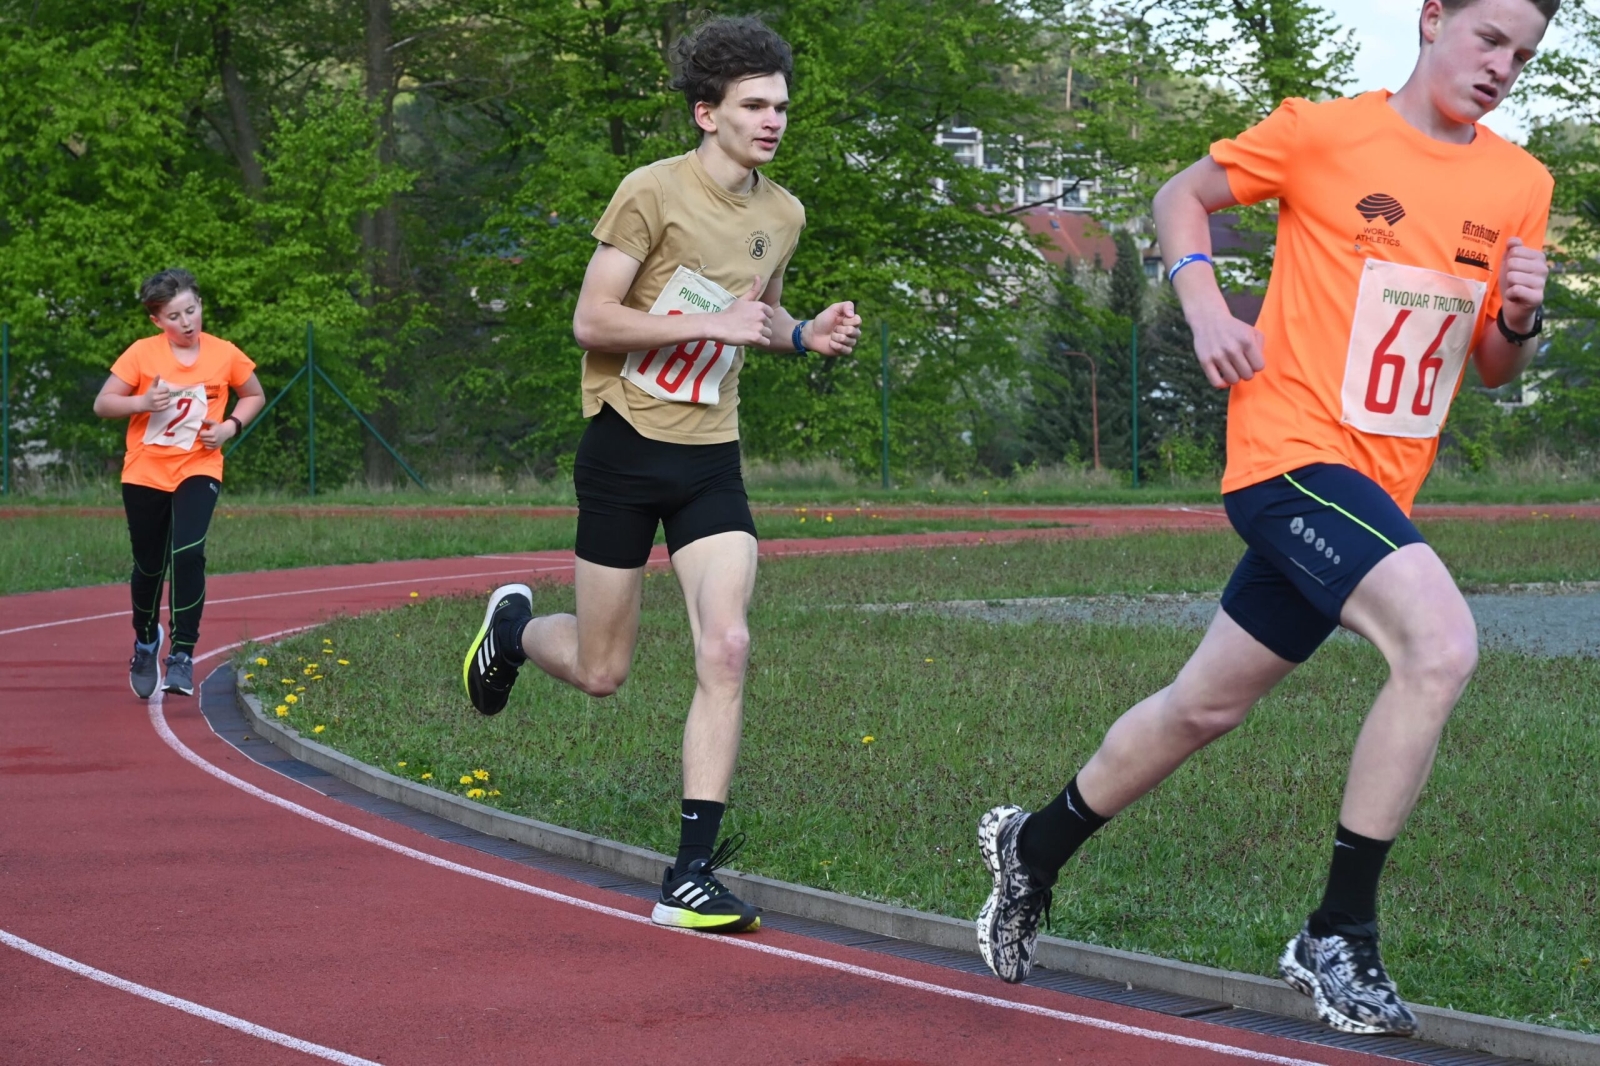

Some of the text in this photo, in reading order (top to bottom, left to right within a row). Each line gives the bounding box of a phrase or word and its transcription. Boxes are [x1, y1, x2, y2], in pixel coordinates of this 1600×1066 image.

[1355, 233, 1401, 247] ATHLETICS
[1363, 227, 1395, 238] WORLD
[679, 286, 711, 312] PIVOVAR
[1382, 288, 1430, 309] PIVOVAR
[1364, 309, 1458, 416] 66
[163, 398, 192, 437] 2
